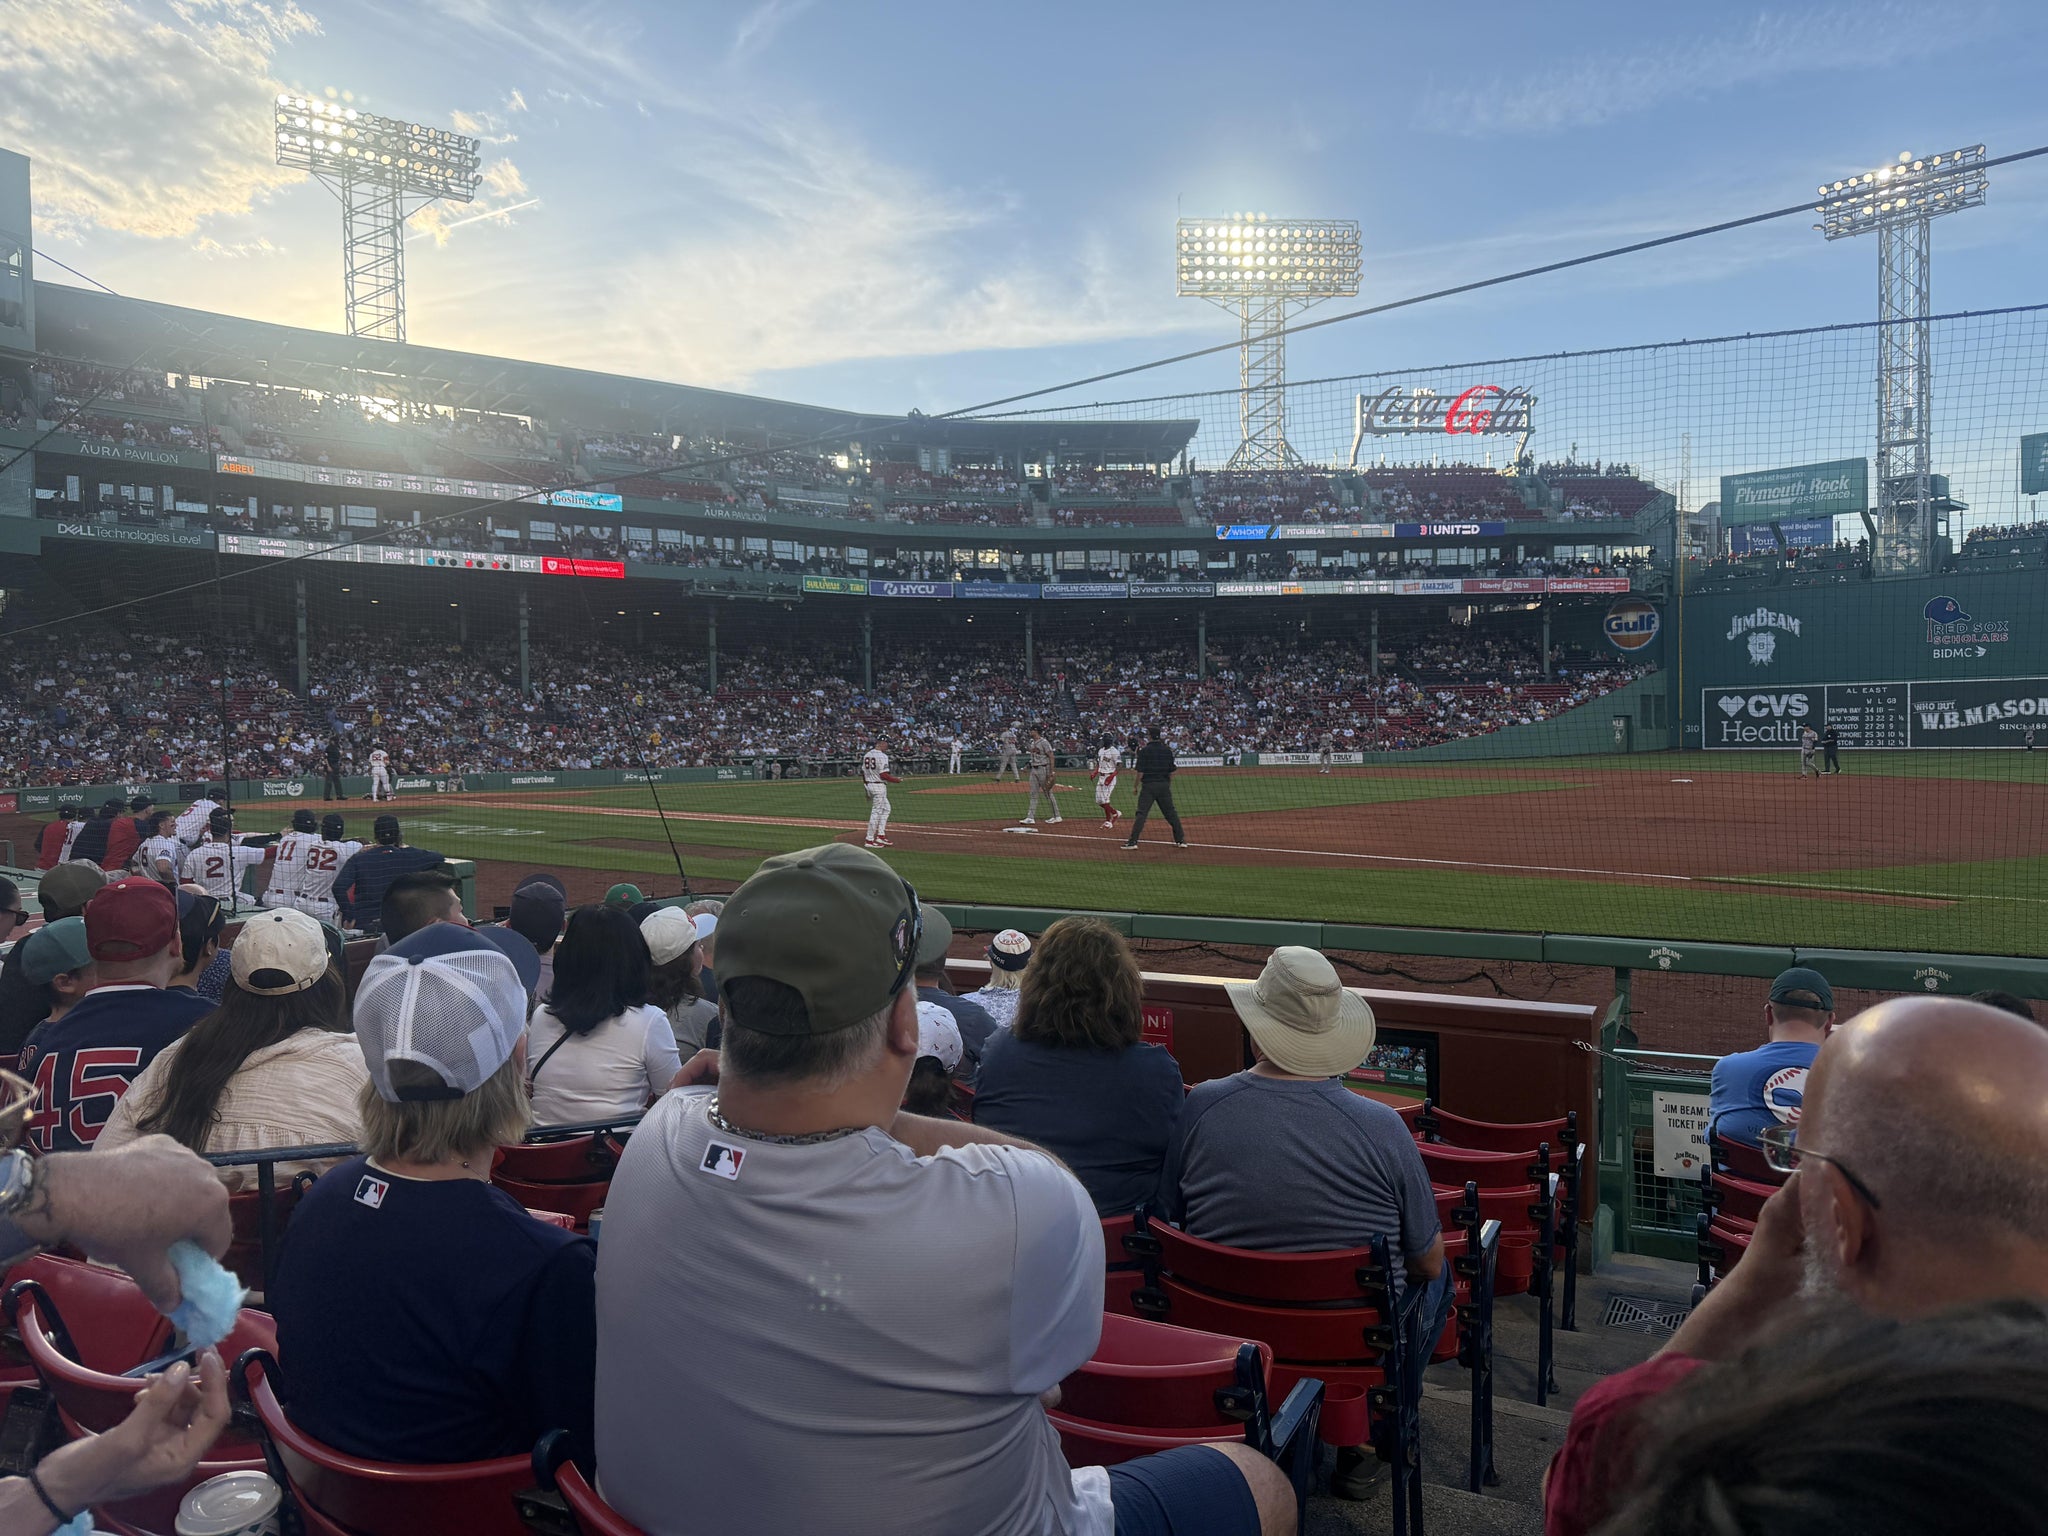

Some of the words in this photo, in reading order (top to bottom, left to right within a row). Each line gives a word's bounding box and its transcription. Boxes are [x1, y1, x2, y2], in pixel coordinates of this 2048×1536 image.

[124, 449, 178, 464] PAVILION
[222, 463, 255, 474] ABREU
[1735, 480, 1807, 504] Plymouth
[1809, 475, 1851, 494] Rock
[554, 494, 594, 507] Goslings
[731, 510, 767, 522] PAVILION
[1433, 525, 1480, 535] UNITED
[1795, 520, 1822, 531] Brigham
[57, 523, 94, 536] DELL
[94, 525, 170, 544] Technologies
[172, 533, 201, 544] Level
[1752, 537, 1775, 546] Your
[462, 552, 487, 561] STRIKE
[900, 582, 935, 594] HYCU
[1606, 613, 1656, 633] Gulf
[1727, 614, 1756, 641] JIM
[1756, 607, 1801, 637] BEAM
[1933, 623, 1968, 635] RED
[1973, 621, 2009, 633] SOX
[1933, 632, 2009, 645] SCHOLARS
[1933, 648, 1972, 659] BIDMC
[1748, 694, 1809, 718] CVS
[1914, 702, 1935, 710] WHO
[1685, 725, 1699, 733] 310
[396, 778, 431, 790] Franklin
[511, 775, 556, 784] smartwater
[58, 793, 83, 802] xfinity
[278, 841, 297, 862] 11
[306, 850, 338, 871] 32
[205, 856, 224, 879] 2
[1649, 949, 1661, 959] JIM
[1661, 946, 1680, 961] BEAM
[1913, 969, 1928, 980] JIM
[1928, 967, 1949, 982] BEAM
[30, 1047, 142, 1150] 45
[1663, 1104, 1678, 1114] JIM
[1668, 1118, 1695, 1130] TICKET
[1691, 1134, 1706, 1145] ONL
